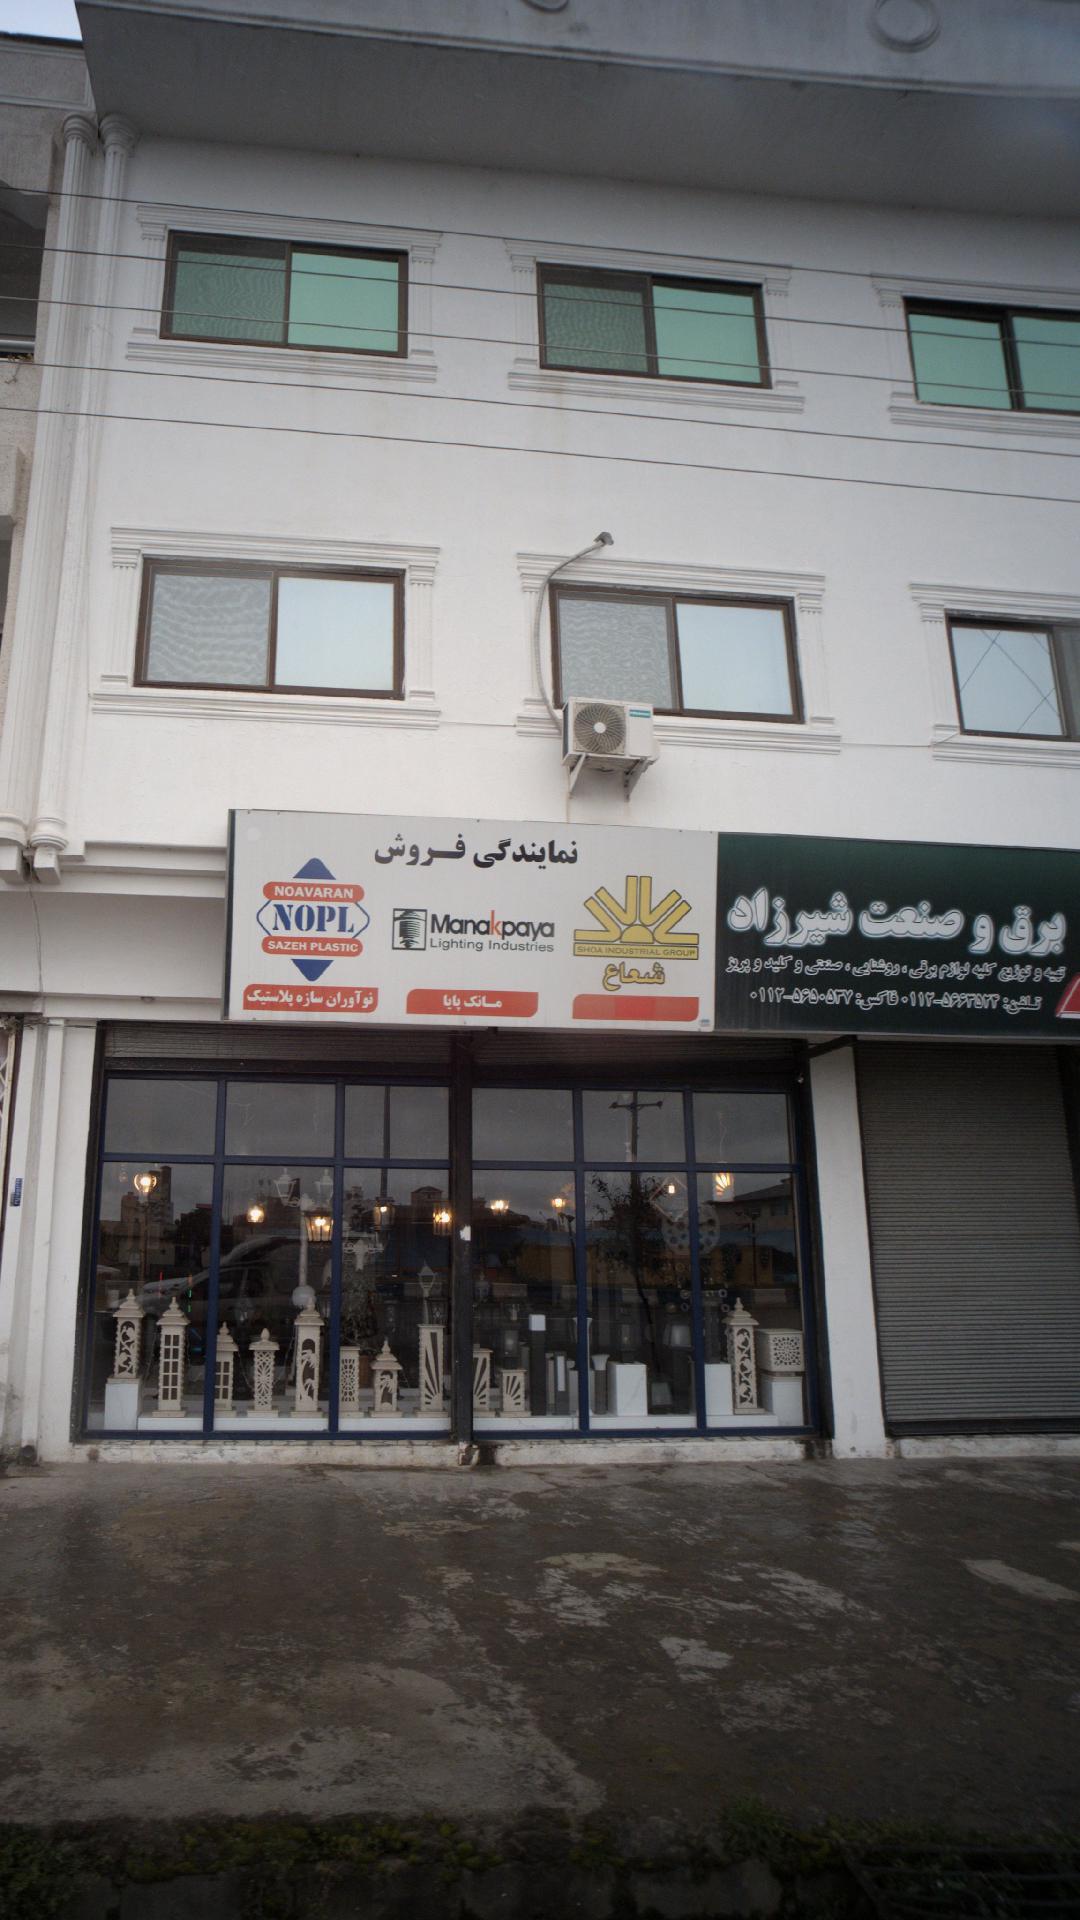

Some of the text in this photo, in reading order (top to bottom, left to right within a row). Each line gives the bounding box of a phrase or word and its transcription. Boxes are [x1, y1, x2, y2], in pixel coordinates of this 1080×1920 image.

[473, 838, 578, 869] نمایندگی
[274, 886, 353, 899] NOAVARAN
[272, 904, 354, 932] NOPL
[431, 910, 555, 941] Manakpaya
[727, 887, 1066, 954] برق و صنعت شیرزاد
[268, 941, 358, 952] SAZEH PLASTIC
[430, 938, 554, 952] Lighting Industries
[577, 946, 603, 954] SHOA
[605, 948, 661, 956] INDUSTRIAL
[725, 956, 751, 974] پریز
[753, 957, 762, 973] و
[764, 955, 793, 973] کلید
[794, 959, 803, 974] و
[804, 958, 843, 976] صنعتی
[939, 961, 970, 981] لوازم
[972, 962, 997, 980] کلیه
[602, 961, 665, 991] شعاع
[998, 964, 1032, 982] توزیع
[1034, 967, 1043, 983] و
[1043, 966, 1067, 983] تهیه
[247, 990, 293, 1006] پلاستیک
[296, 991, 323, 1007] سازه
[443, 994, 461, 1011] پایا
